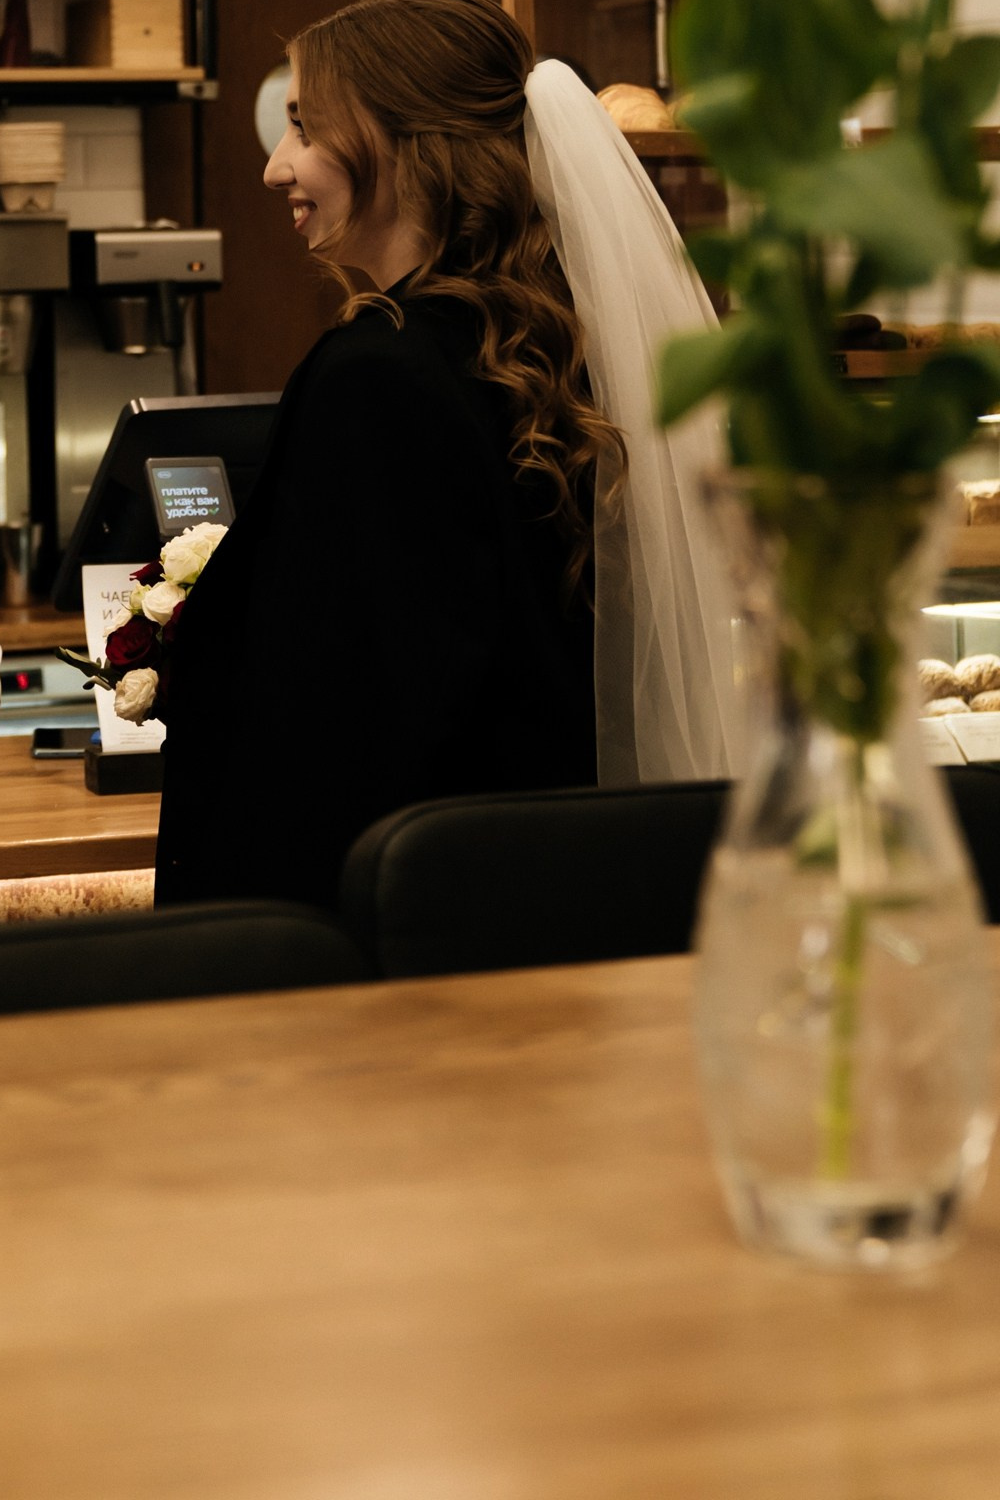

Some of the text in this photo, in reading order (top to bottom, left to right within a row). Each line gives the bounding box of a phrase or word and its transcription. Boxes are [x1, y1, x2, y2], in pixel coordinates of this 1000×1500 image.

[161, 486, 208, 497] платите
[173, 496, 219, 506] как вам
[165, 505, 209, 519] удобно
